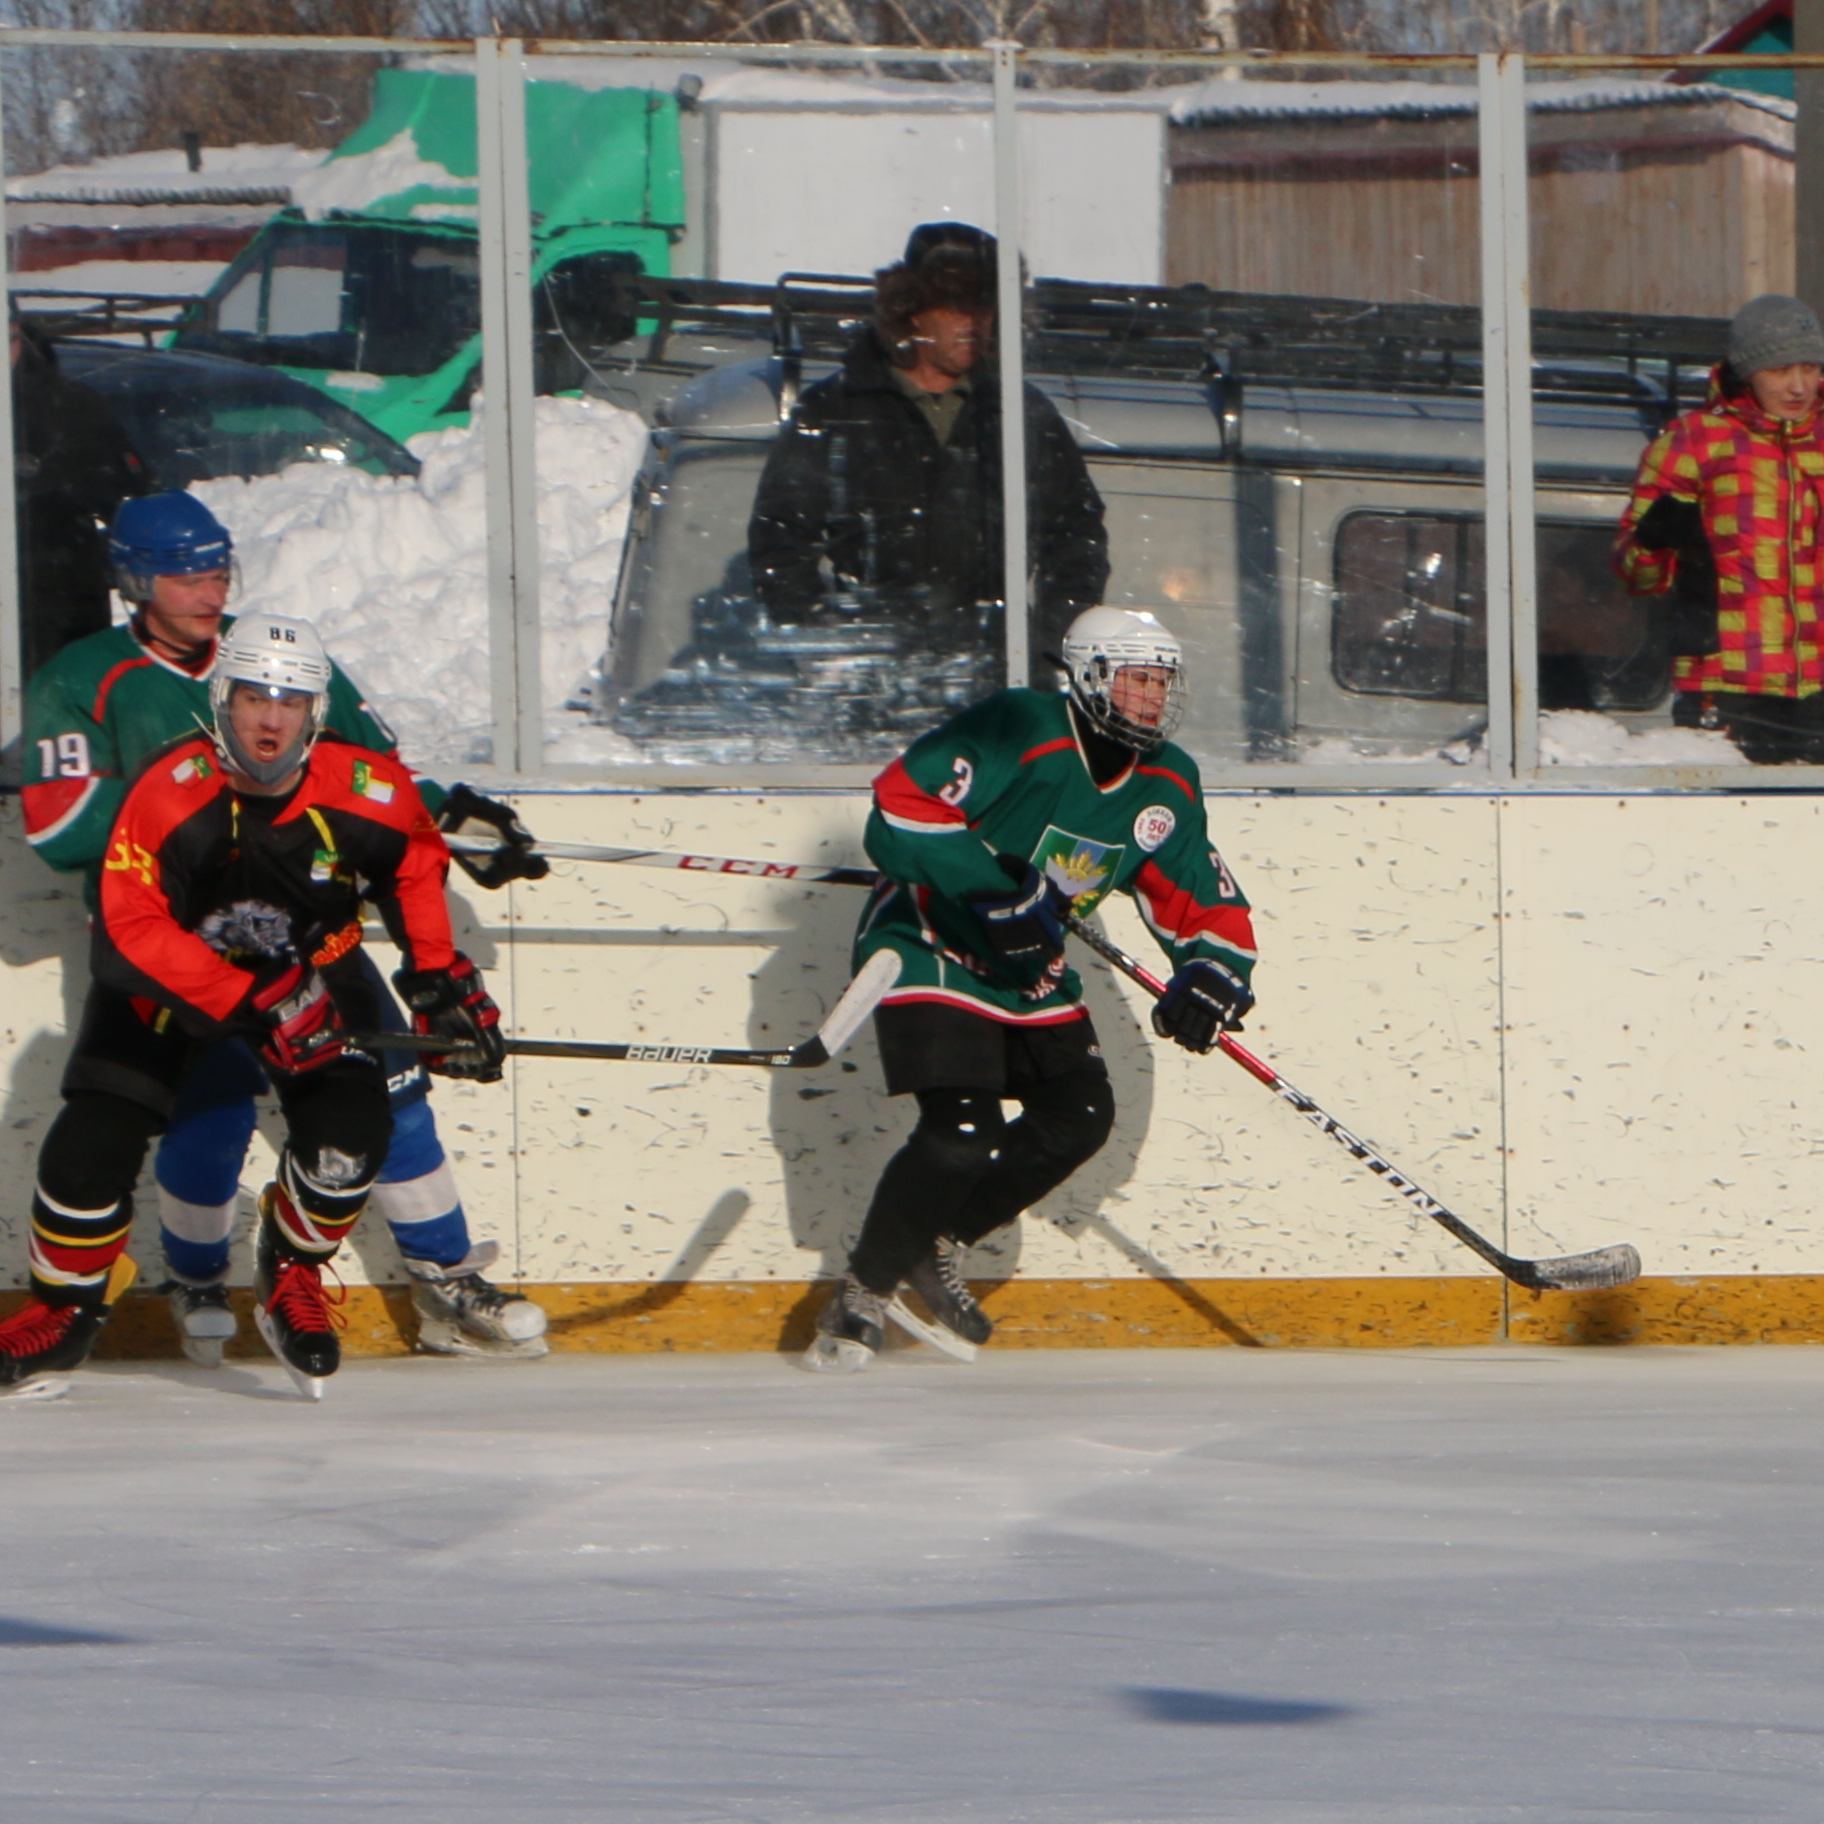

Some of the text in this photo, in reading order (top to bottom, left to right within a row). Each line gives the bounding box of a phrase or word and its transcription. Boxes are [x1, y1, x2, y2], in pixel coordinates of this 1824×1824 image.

[269, 626, 296, 643] 86
[36, 731, 92, 778] 19
[938, 756, 973, 806] 3
[1148, 819, 1167, 834] 50
[678, 855, 800, 879] CCM
[1208, 851, 1237, 899] 3
[1276, 1080, 1448, 1217] EASTON
